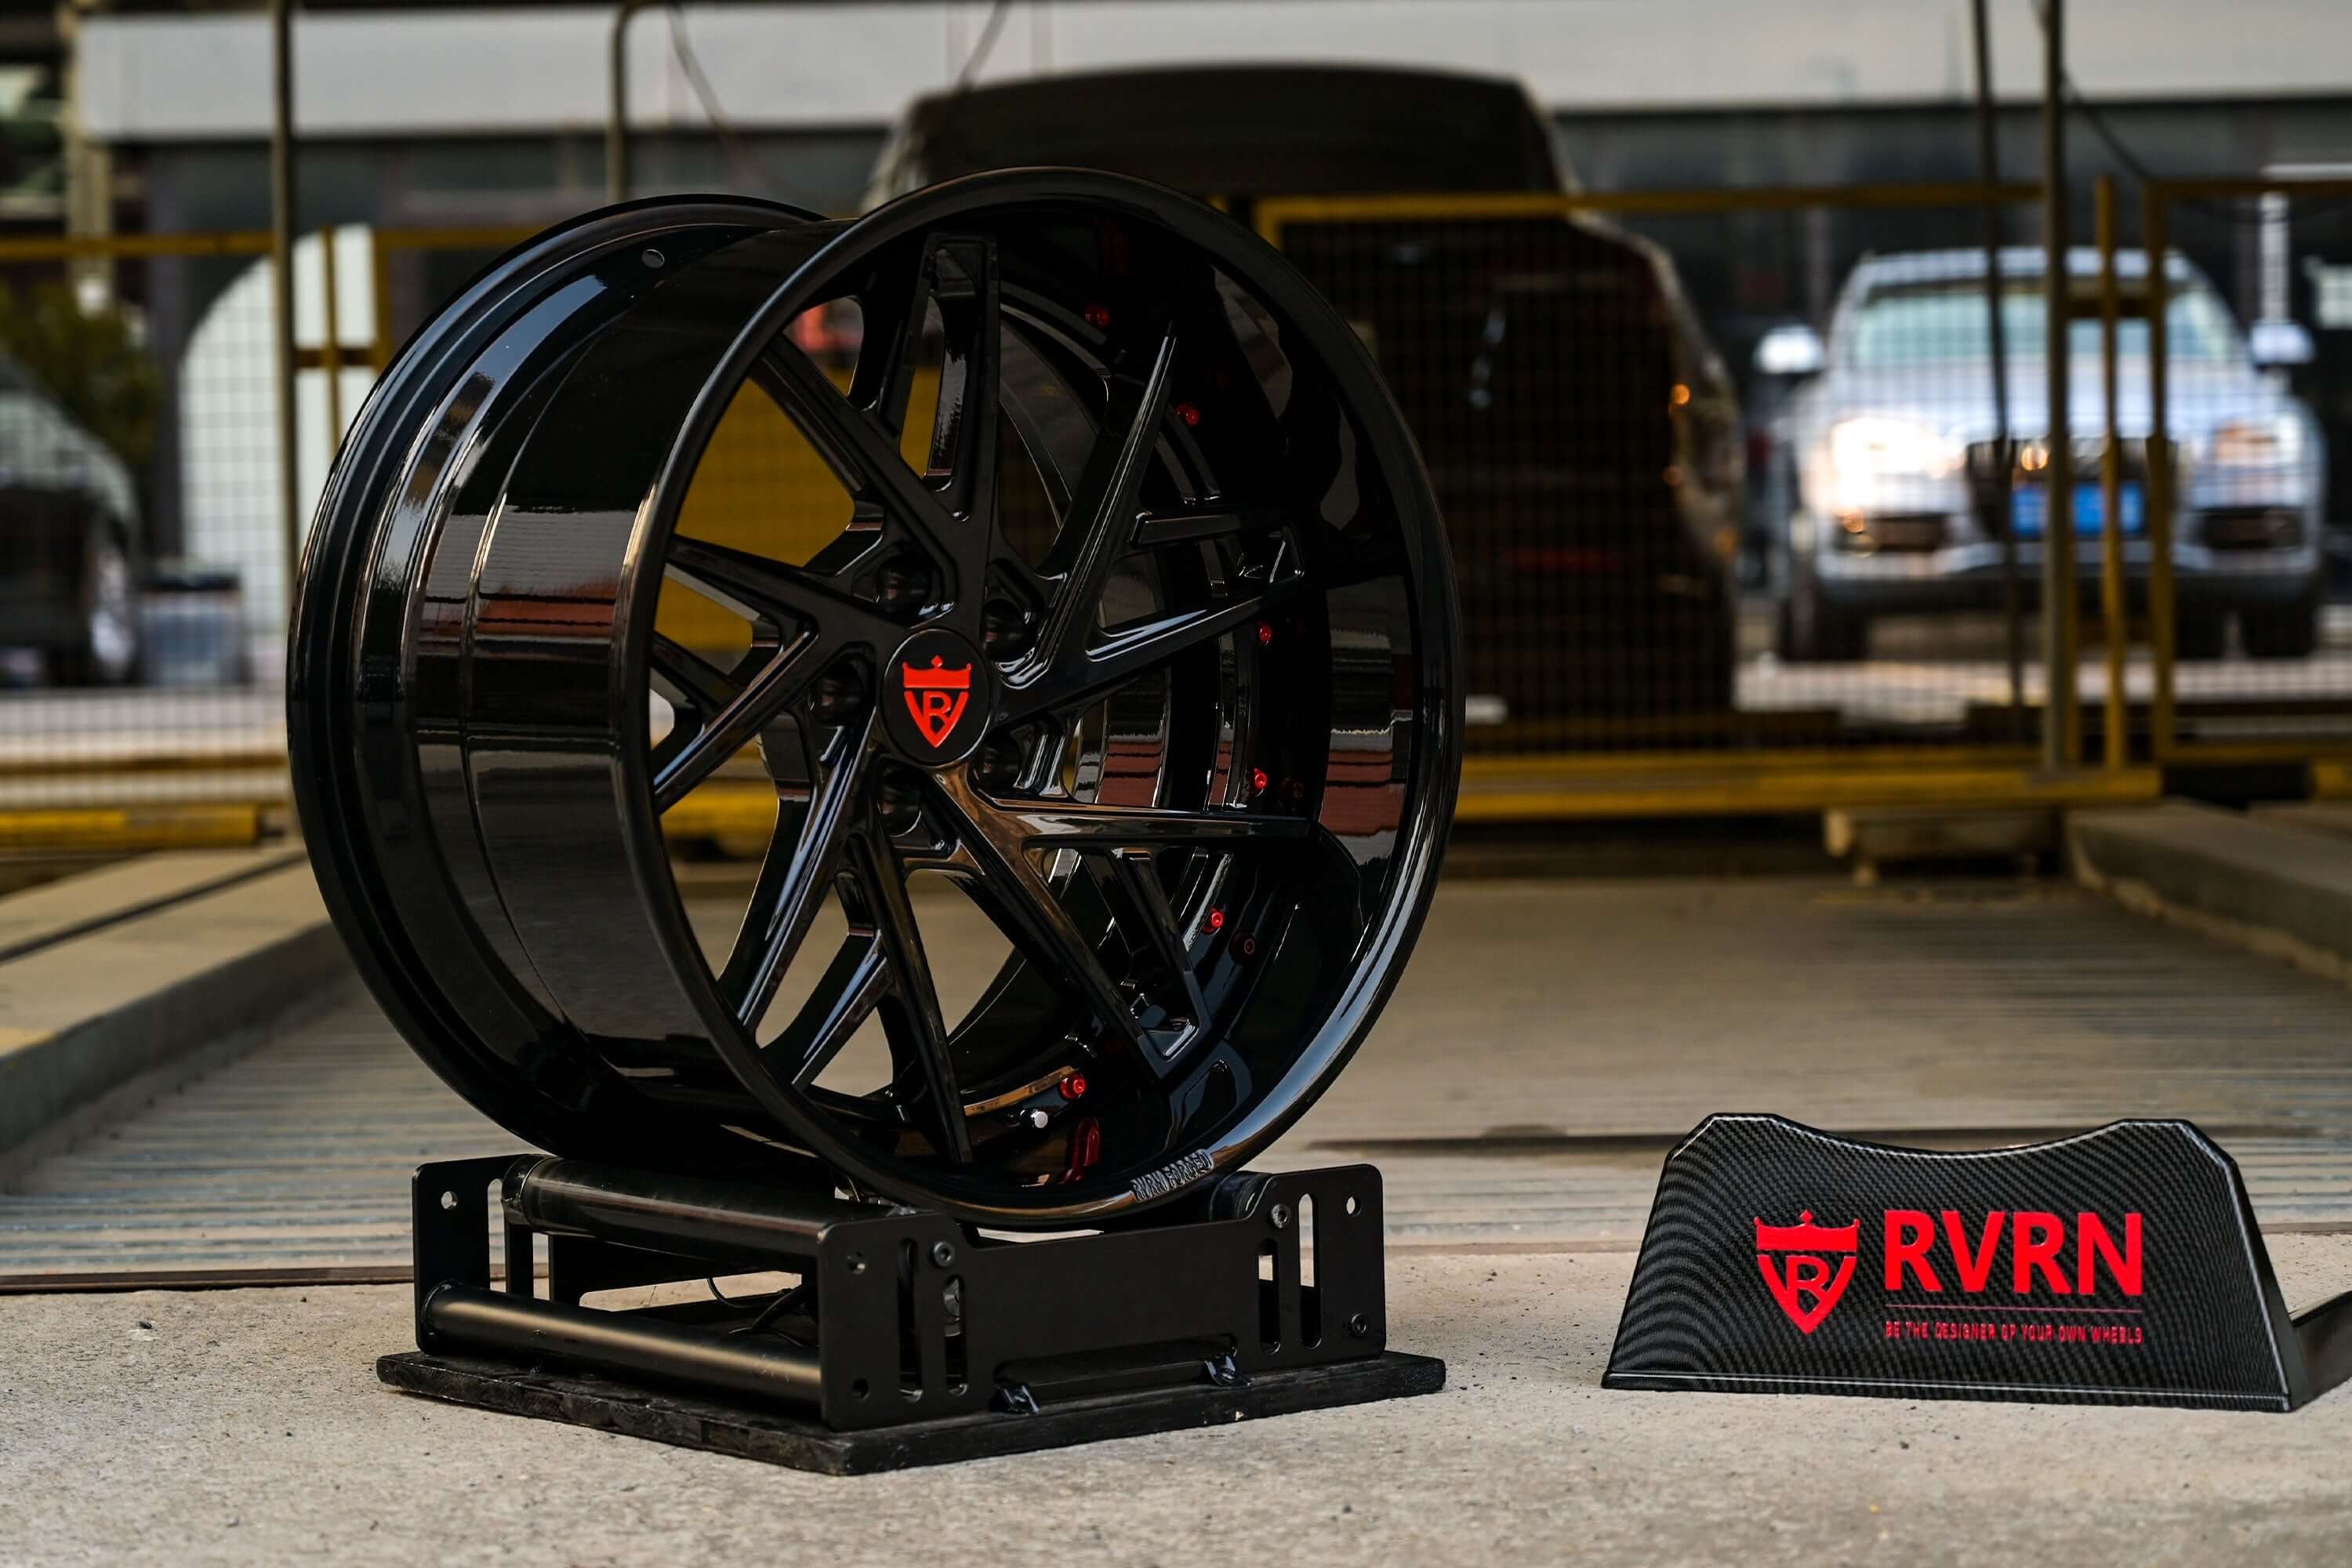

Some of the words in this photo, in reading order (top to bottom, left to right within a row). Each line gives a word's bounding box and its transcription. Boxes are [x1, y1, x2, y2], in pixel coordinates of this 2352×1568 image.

[1162, 1149, 1214, 1191] FORGED
[1884, 1210, 2143, 1296] RVRN
[1885, 1320, 1901, 1340] BE
[1905, 1320, 1930, 1340] THE
[1934, 1321, 1997, 1342] DESIGNER
[2000, 1323, 2017, 1342] OF
[2020, 1323, 2054, 1343] YOUR
[2057, 1325, 2088, 1343] OWN
[2090, 1325, 2143, 1345] WHEELS
